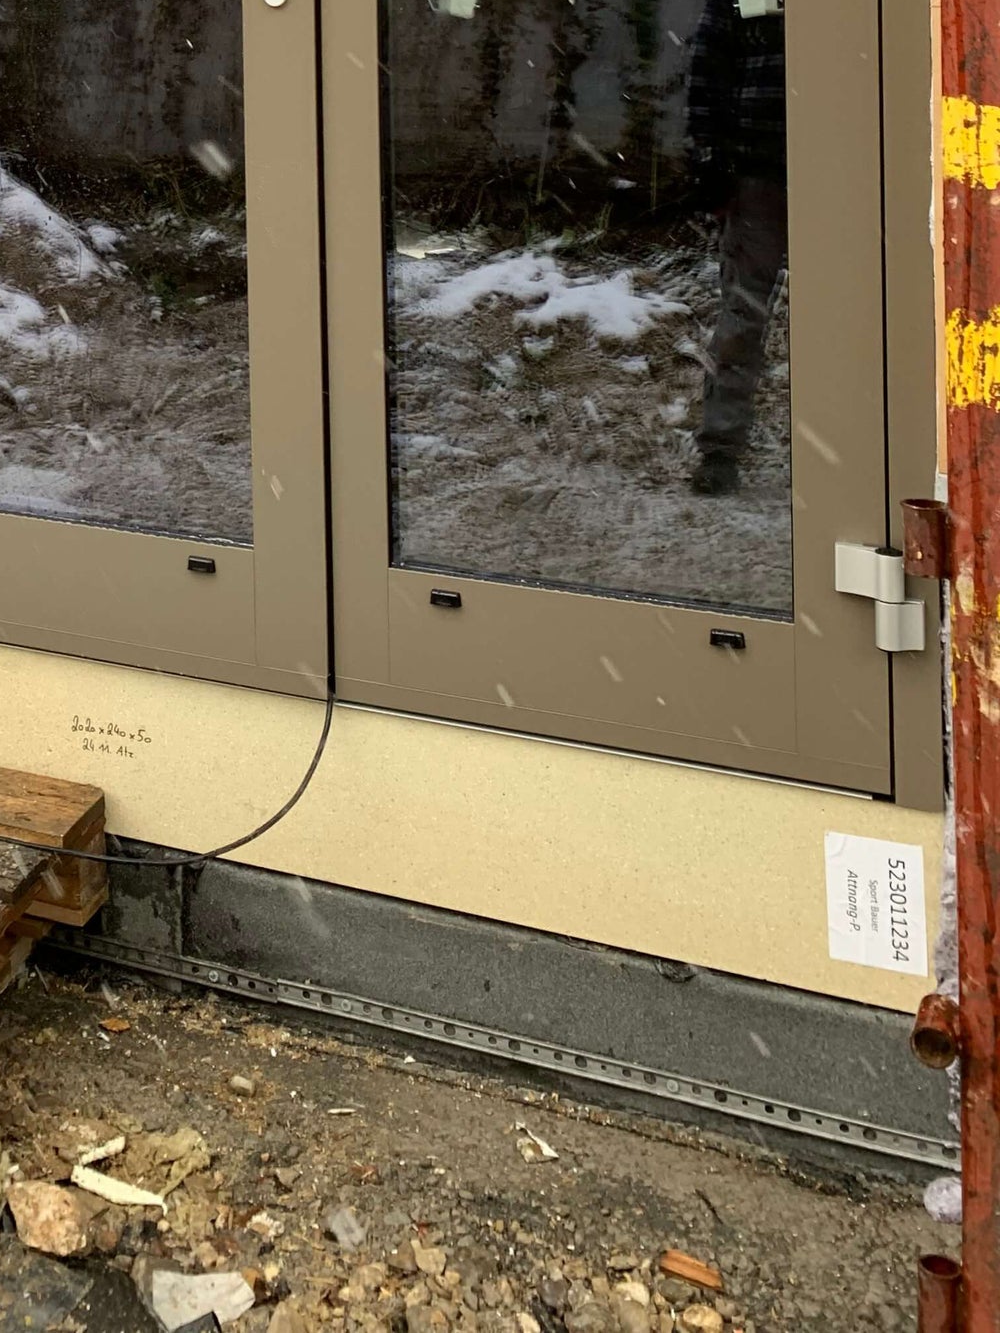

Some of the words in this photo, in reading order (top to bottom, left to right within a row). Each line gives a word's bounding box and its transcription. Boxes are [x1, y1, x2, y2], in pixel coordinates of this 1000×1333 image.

[867, 879, 879, 904] Sport
[869, 906, 880, 932] Bauer
[888, 858, 910, 962] 523011234
